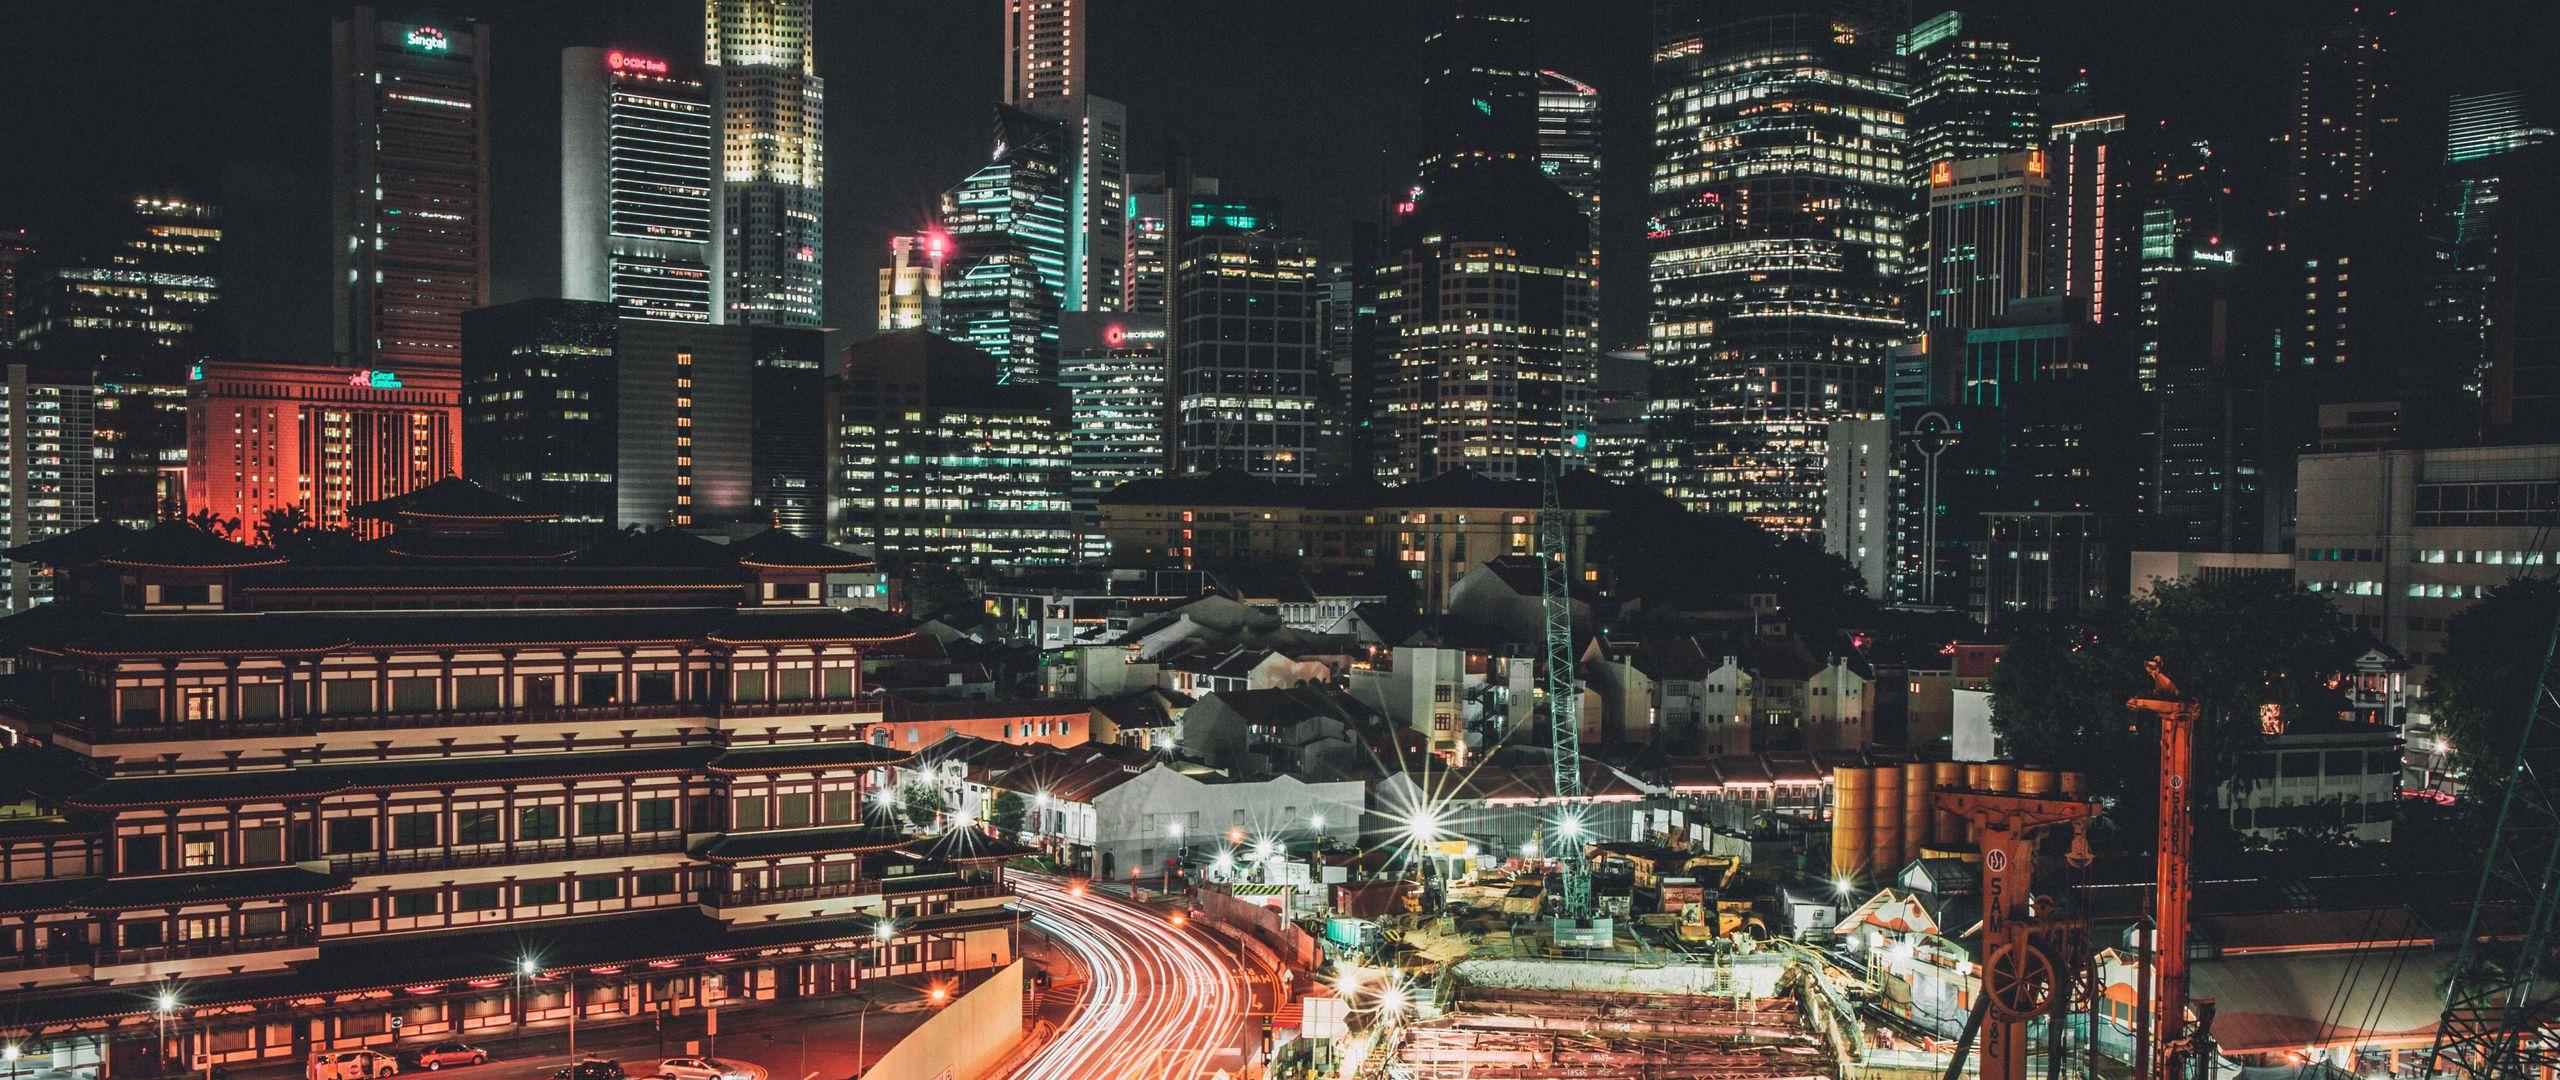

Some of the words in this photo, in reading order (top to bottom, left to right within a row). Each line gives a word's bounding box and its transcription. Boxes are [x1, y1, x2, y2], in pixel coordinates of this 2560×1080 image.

[408, 33, 446, 49] Singtel
[623, 57, 646, 69] OCBC
[647, 60, 666, 71] Bank
[2213, 253, 2224, 261] Bank
[371, 370, 394, 380] Great
[371, 379, 402, 388] Eastern
